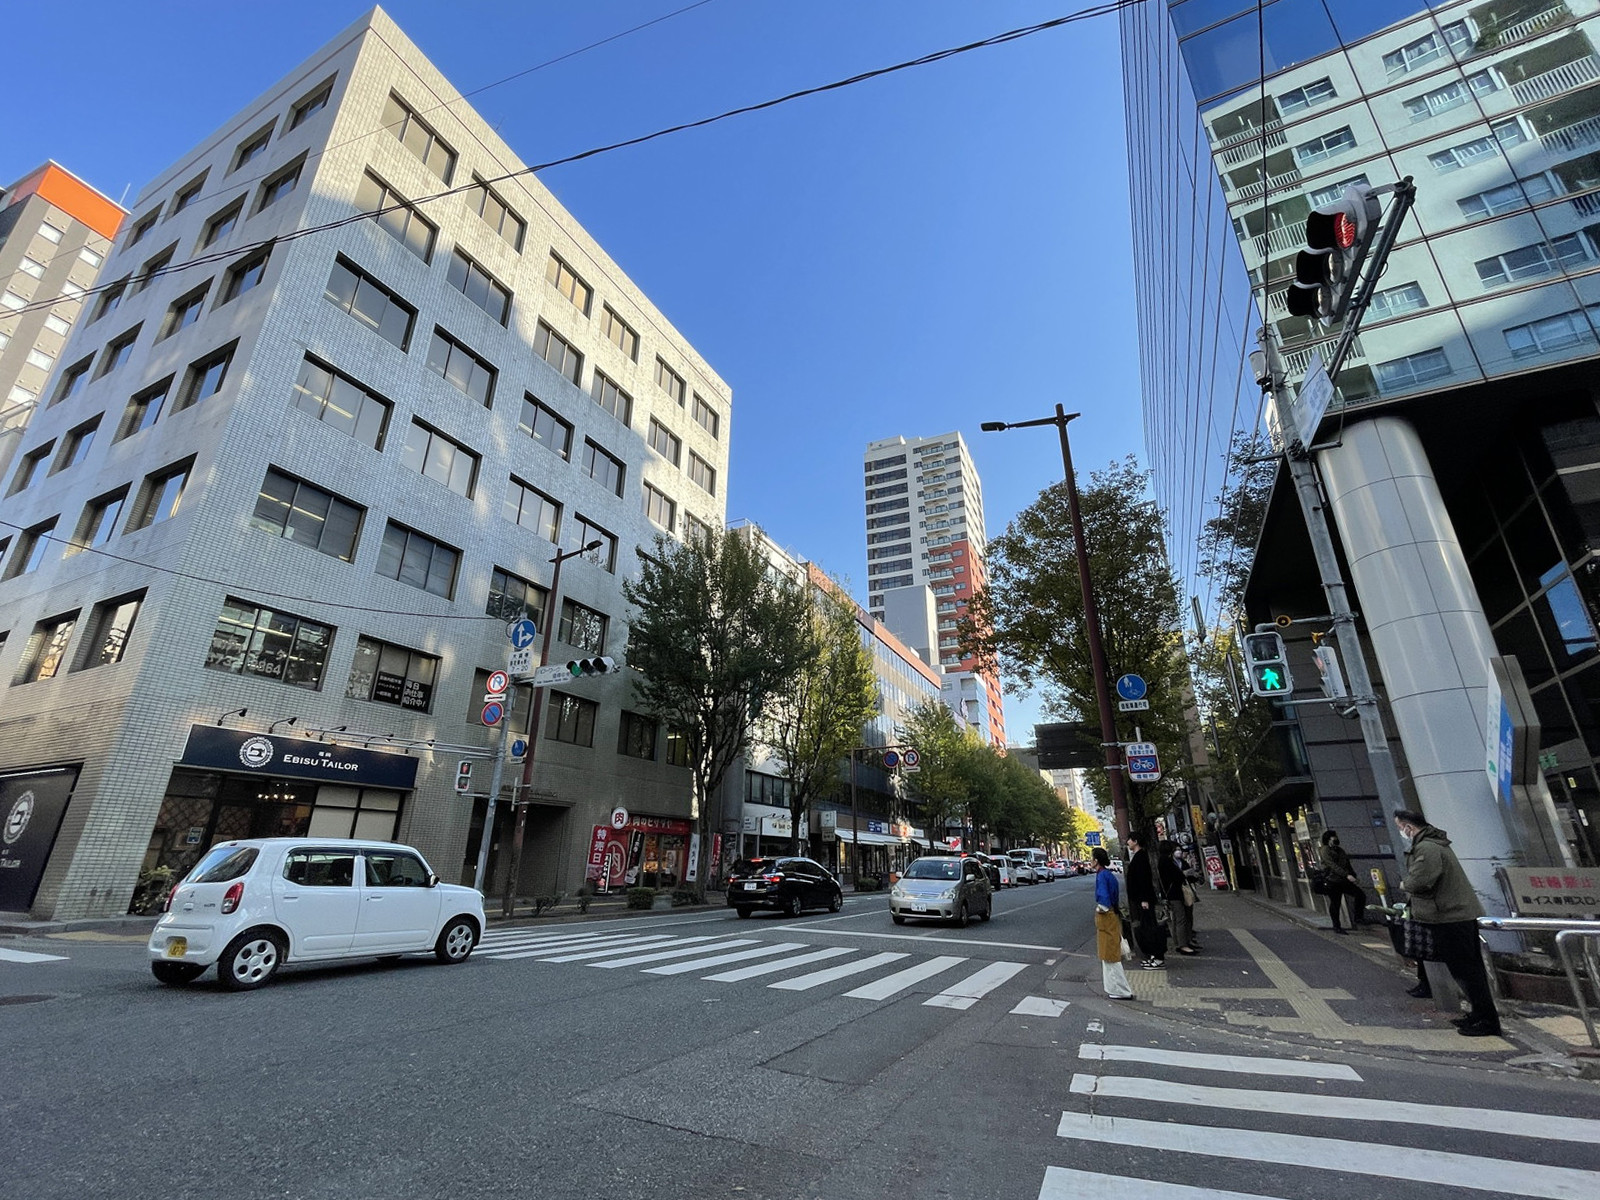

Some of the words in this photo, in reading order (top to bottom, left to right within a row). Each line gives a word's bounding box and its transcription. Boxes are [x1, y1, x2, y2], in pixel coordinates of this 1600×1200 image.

[283, 754, 319, 766] EBISU
[321, 758, 359, 771] TAILOR
[614, 812, 625, 825] 肉
